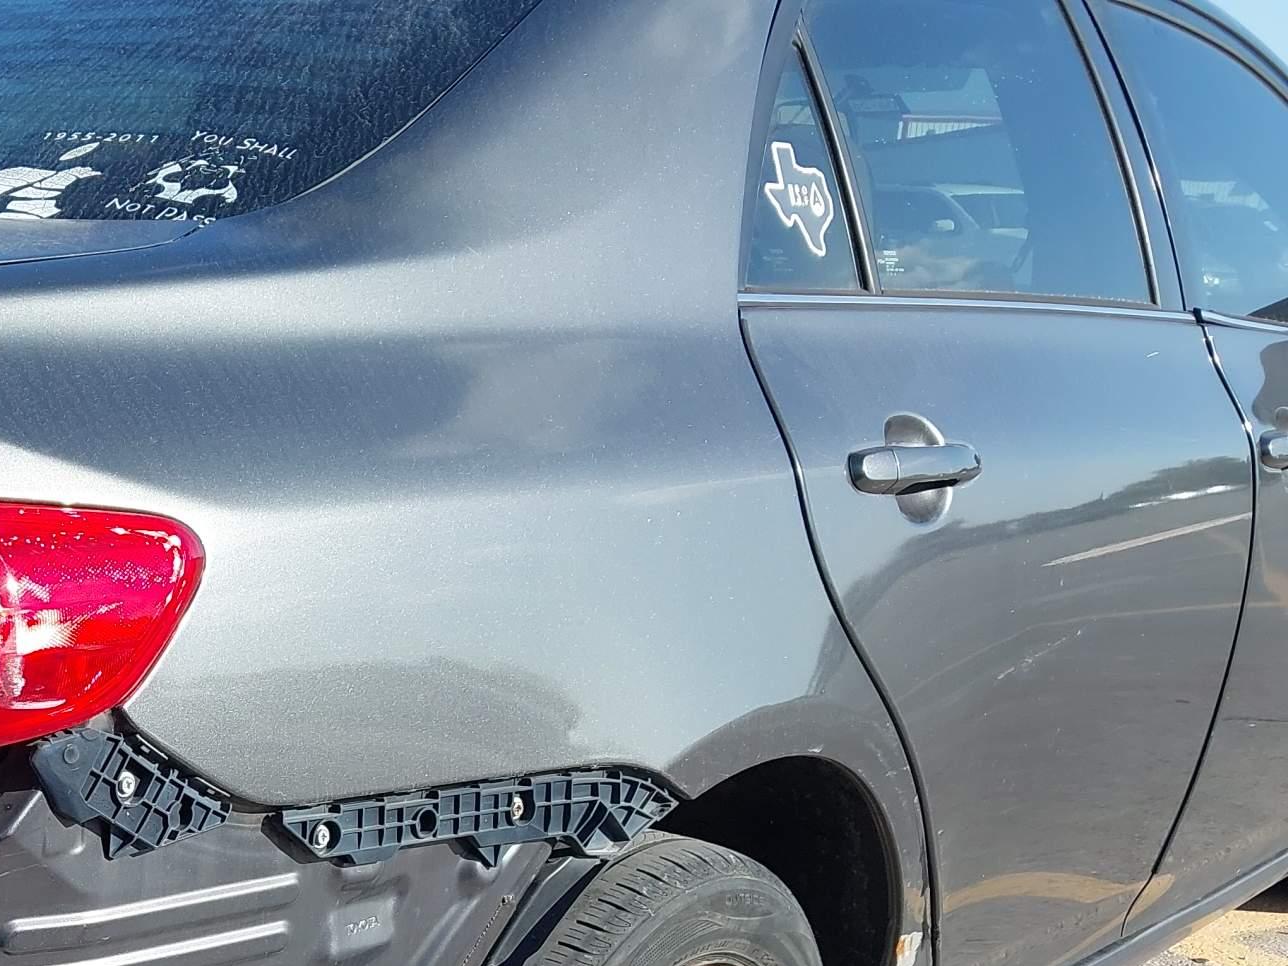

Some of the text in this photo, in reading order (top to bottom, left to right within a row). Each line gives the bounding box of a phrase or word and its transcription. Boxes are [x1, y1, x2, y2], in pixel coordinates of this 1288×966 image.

[43, 131, 159, 144] 1955-2011
[236, 138, 297, 160] SHALL
[105, 197, 155, 214] NOT
